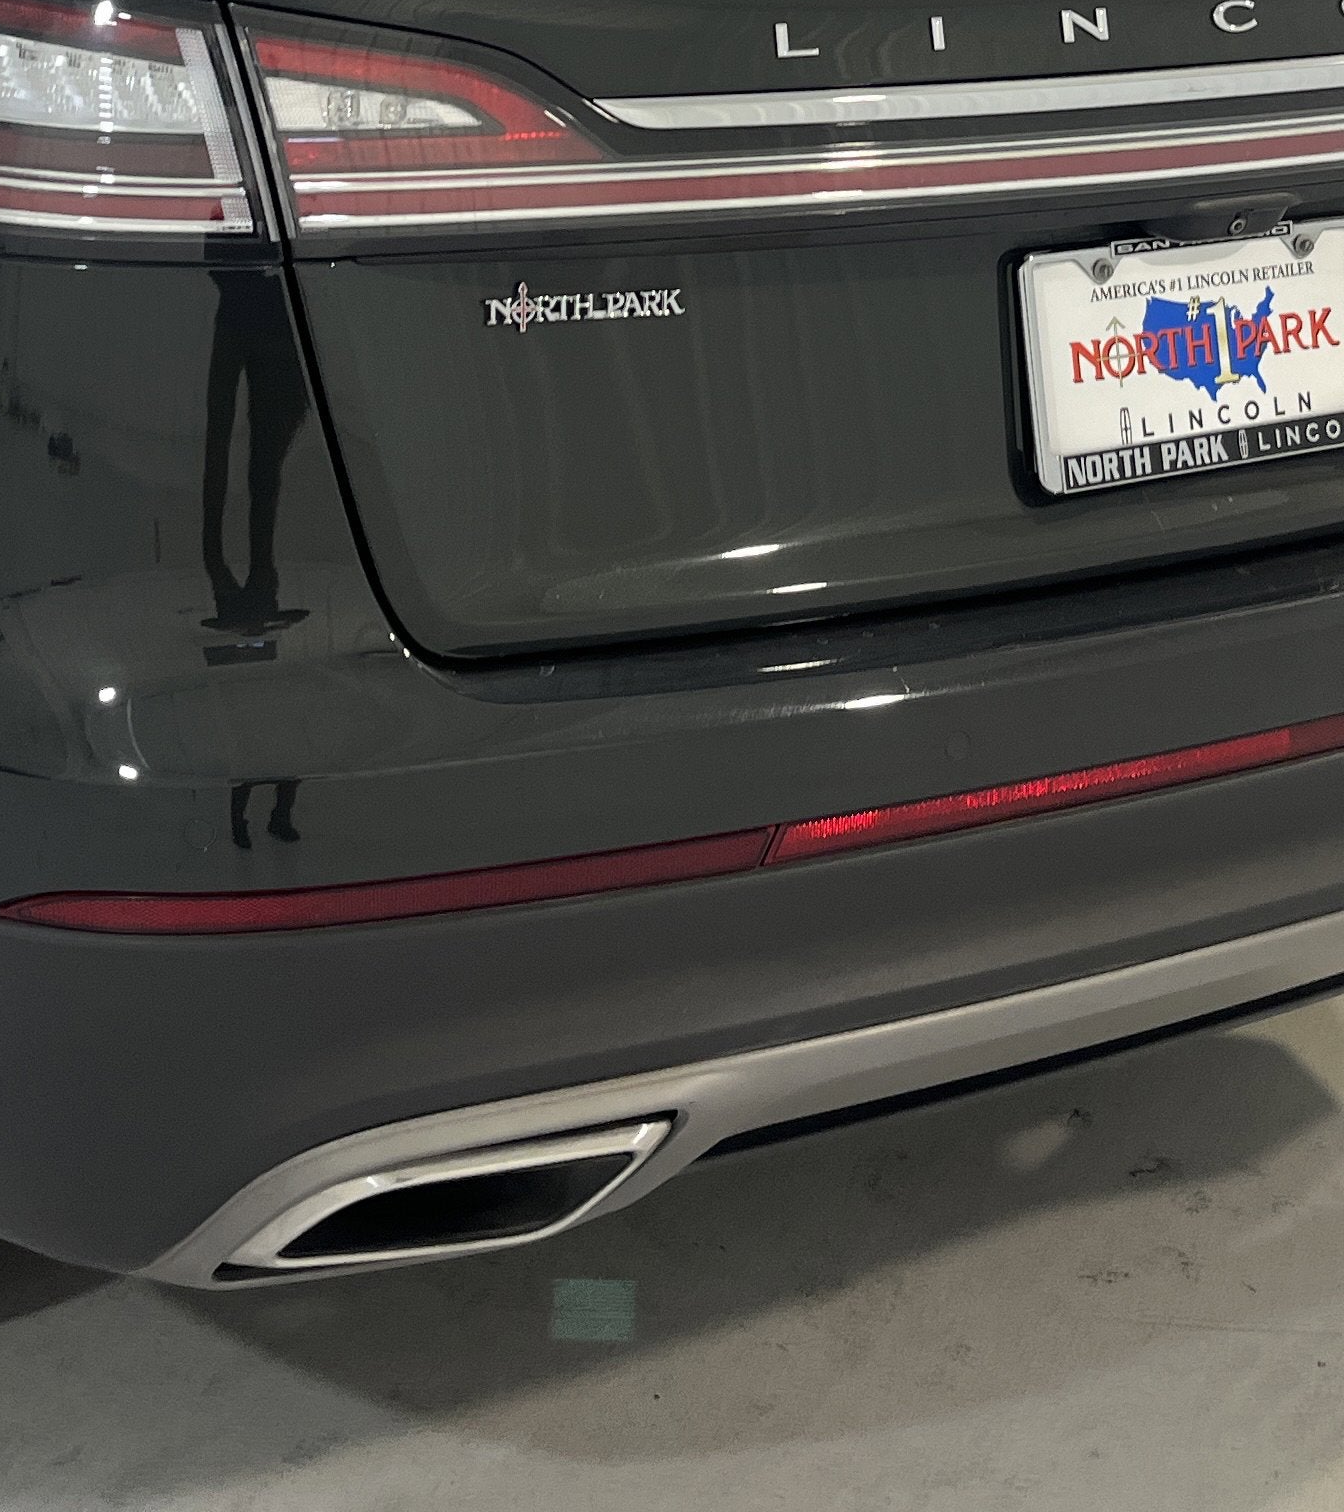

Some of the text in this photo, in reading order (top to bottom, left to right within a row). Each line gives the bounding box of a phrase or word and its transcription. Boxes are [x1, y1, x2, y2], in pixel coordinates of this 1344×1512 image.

[1117, 240, 1170, 255] SAN
[1090, 261, 1315, 303] AMERICA'S #1 LINCOLN RETAILER
[485, 289, 685, 326] NORTH PARK
[1069, 306, 1341, 383] NORTH PARK
[1141, 391, 1312, 437] LINCOLN
[1067, 446, 1152, 488] NORTH
[1161, 434, 1230, 471] PARK
